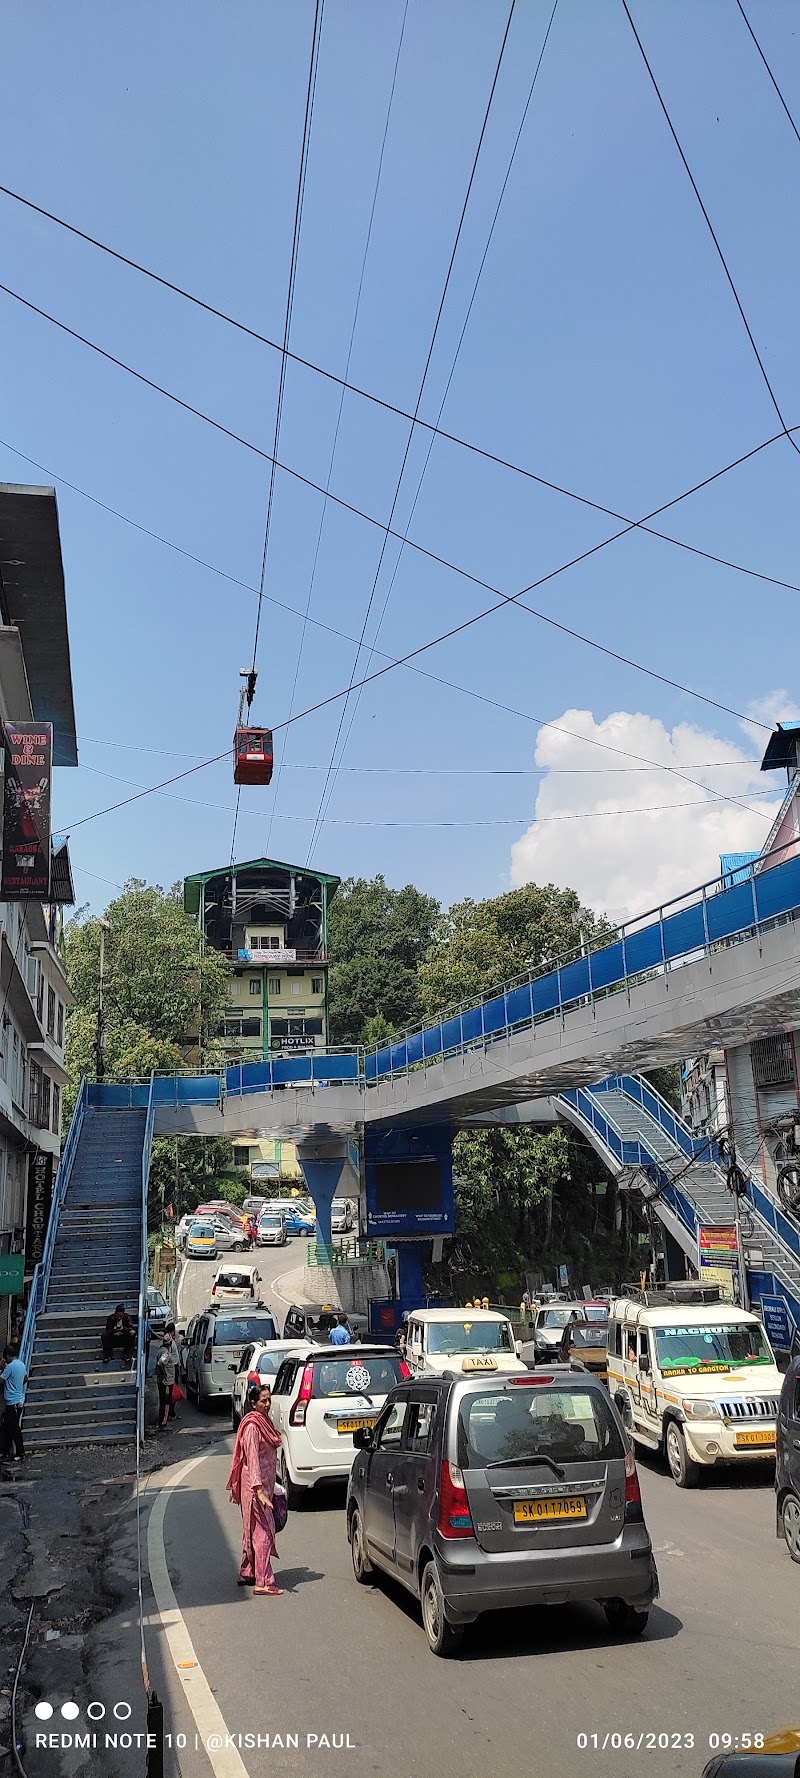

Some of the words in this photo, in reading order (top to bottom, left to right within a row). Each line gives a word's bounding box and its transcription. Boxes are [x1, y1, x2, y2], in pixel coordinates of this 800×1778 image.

[10, 734, 47, 746] WINE
[23, 744, 34, 755] &
[11, 755, 45, 766] DINE
[10, 844, 42, 853] KARAOKE
[281, 1037, 314, 1045] HOTLIX
[34, 1166, 46, 1201] HOTEL
[663, 1326, 750, 1336] NACHUMA
[469, 1358, 494, 1366] TAXI
[663, 1369, 686, 1377] RANKA
[688, 1367, 697, 1375] TO
[698, 1365, 729, 1374] GANGTOK
